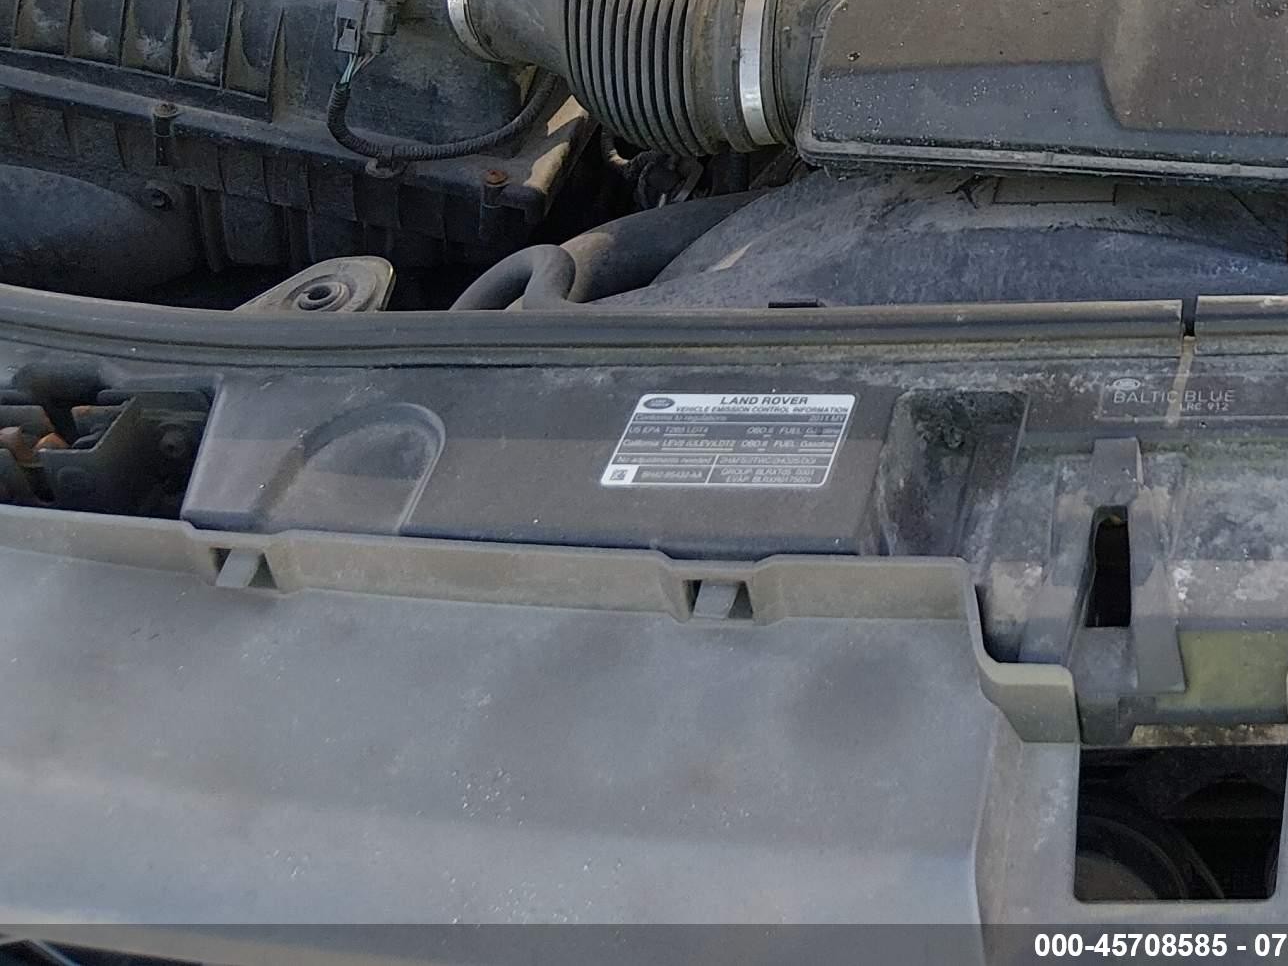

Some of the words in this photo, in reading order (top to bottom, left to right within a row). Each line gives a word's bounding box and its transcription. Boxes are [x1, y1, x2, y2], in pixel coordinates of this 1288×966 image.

[1113, 391, 1178, 404] BALTIC
[1184, 389, 1236, 403] BLUE
[720, 397, 758, 405] LAND
[761, 397, 808, 405] ROVER
[641, 426, 661, 434] EPA
